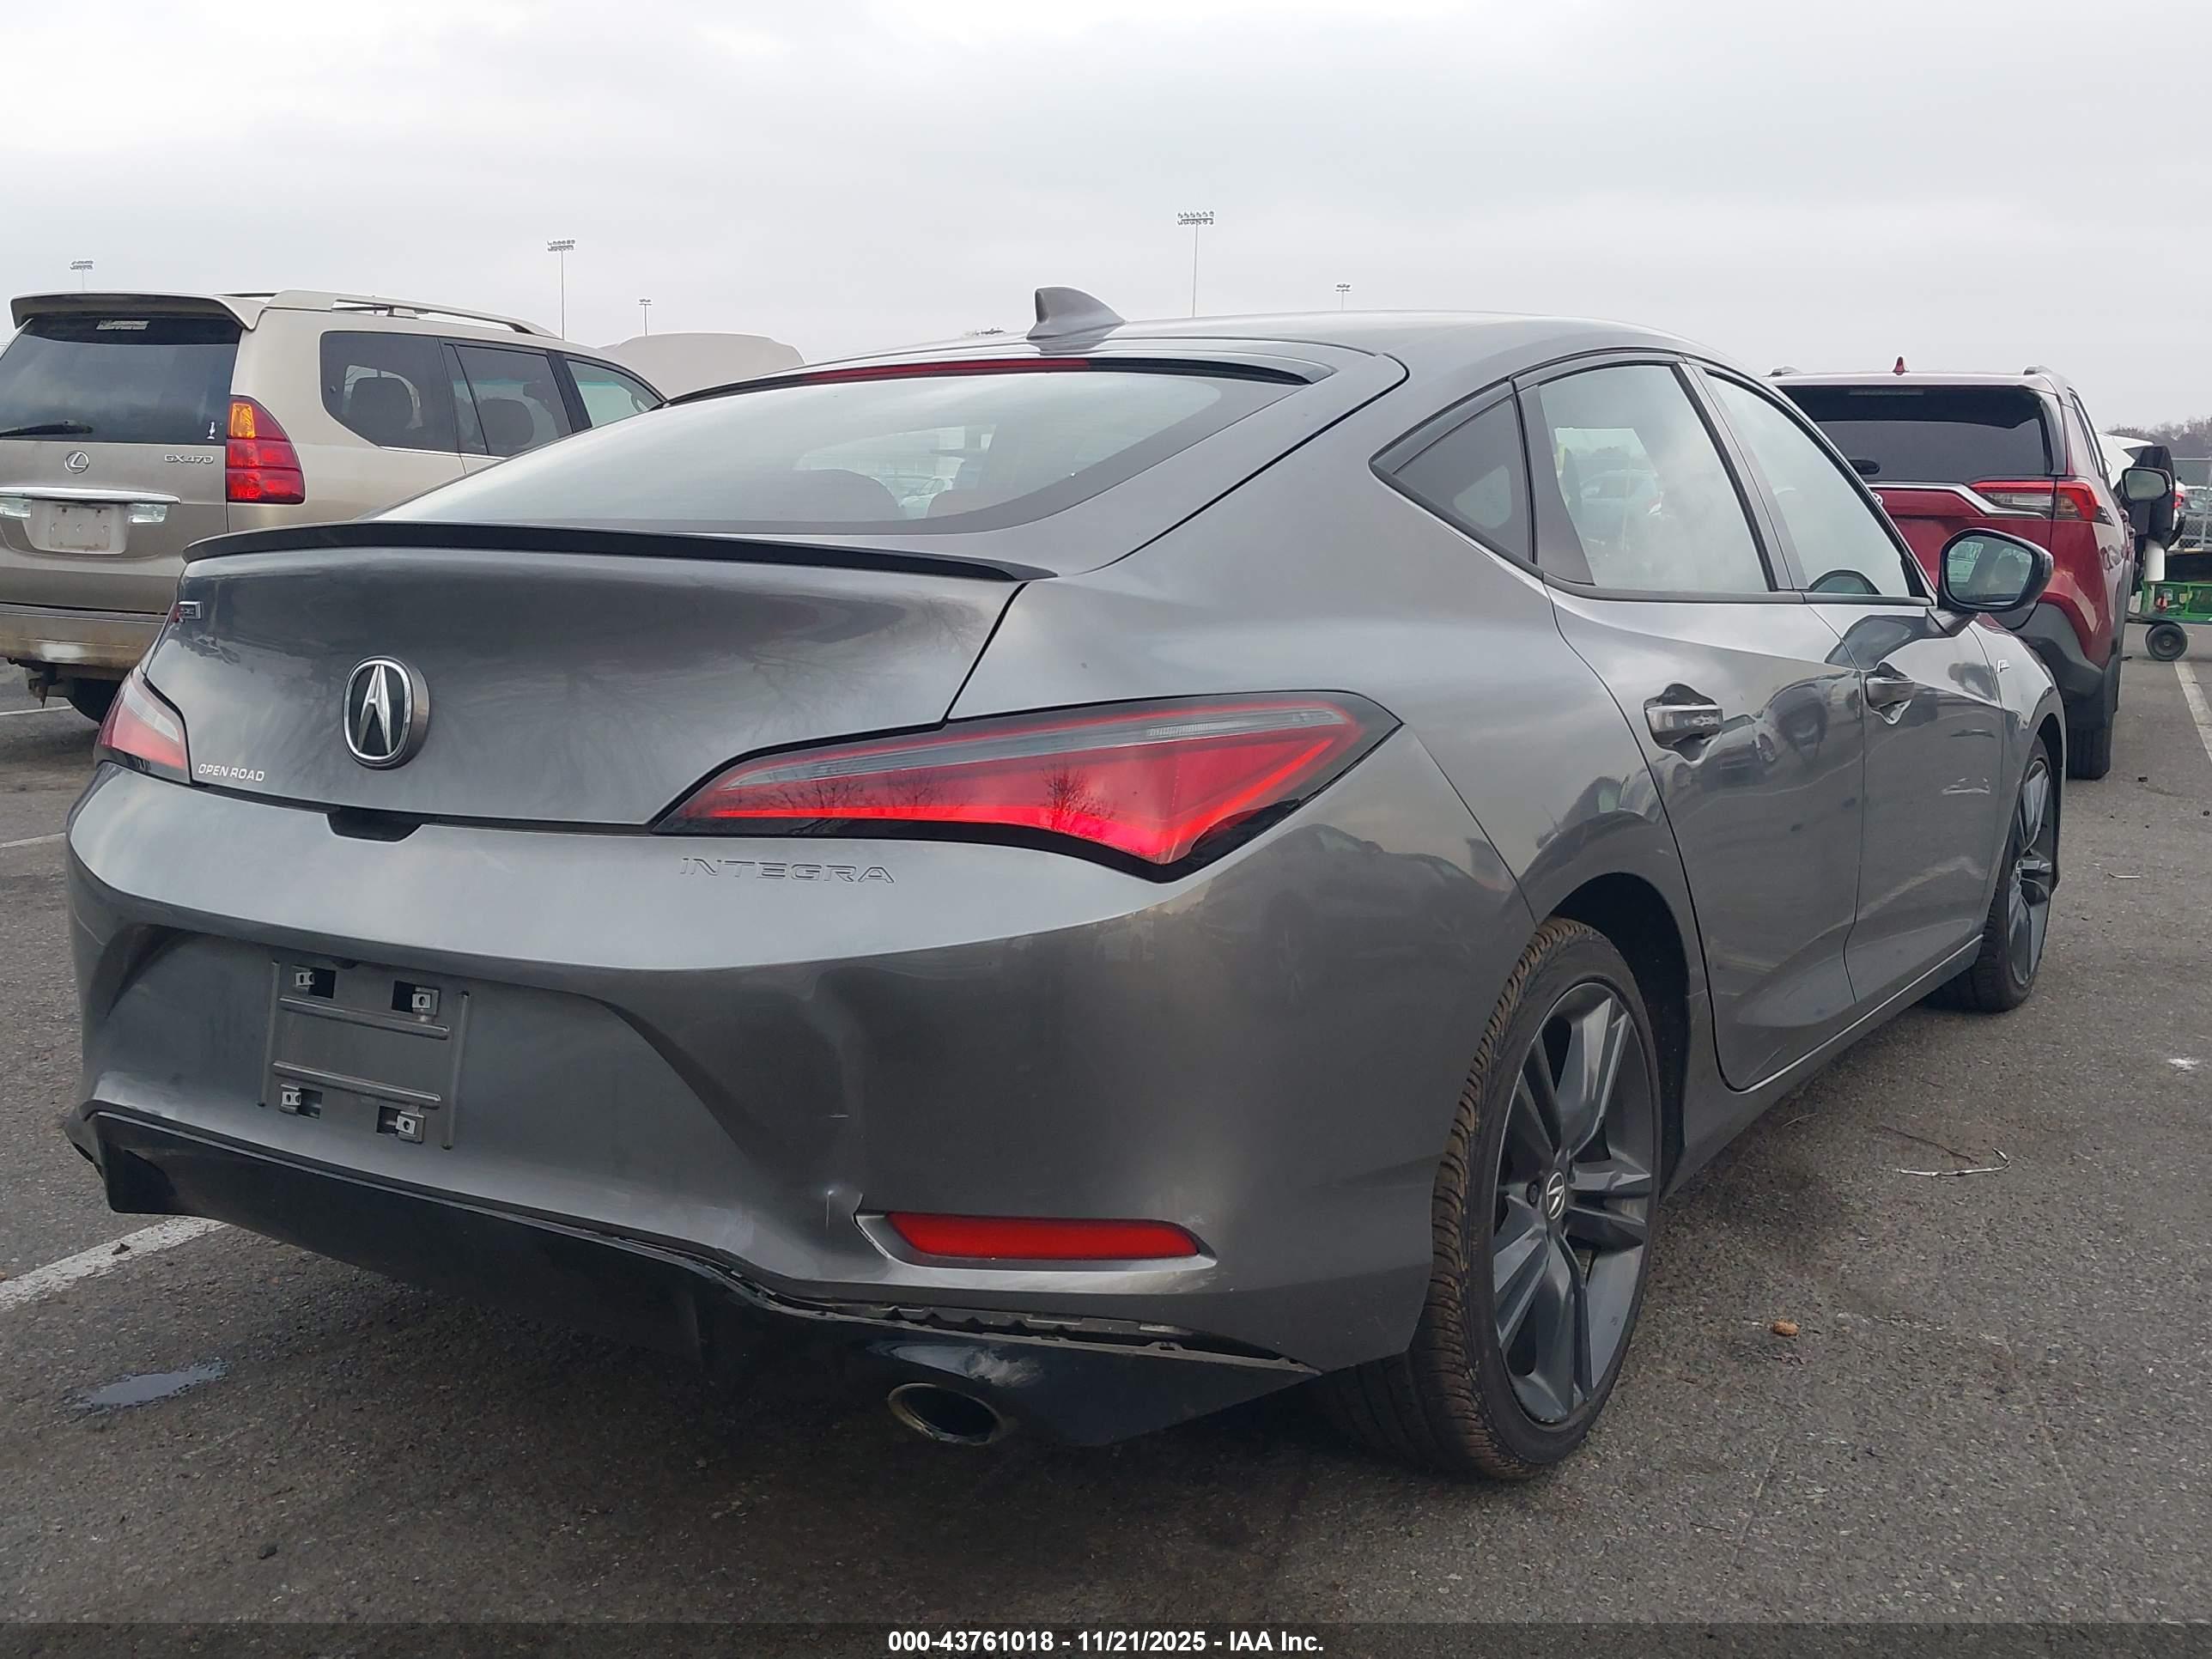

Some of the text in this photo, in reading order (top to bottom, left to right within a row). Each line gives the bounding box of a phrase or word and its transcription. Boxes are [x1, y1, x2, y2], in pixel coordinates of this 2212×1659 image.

[198, 763, 265, 782] OPEN ROAD
[679, 858, 895, 883] INTEGRA
